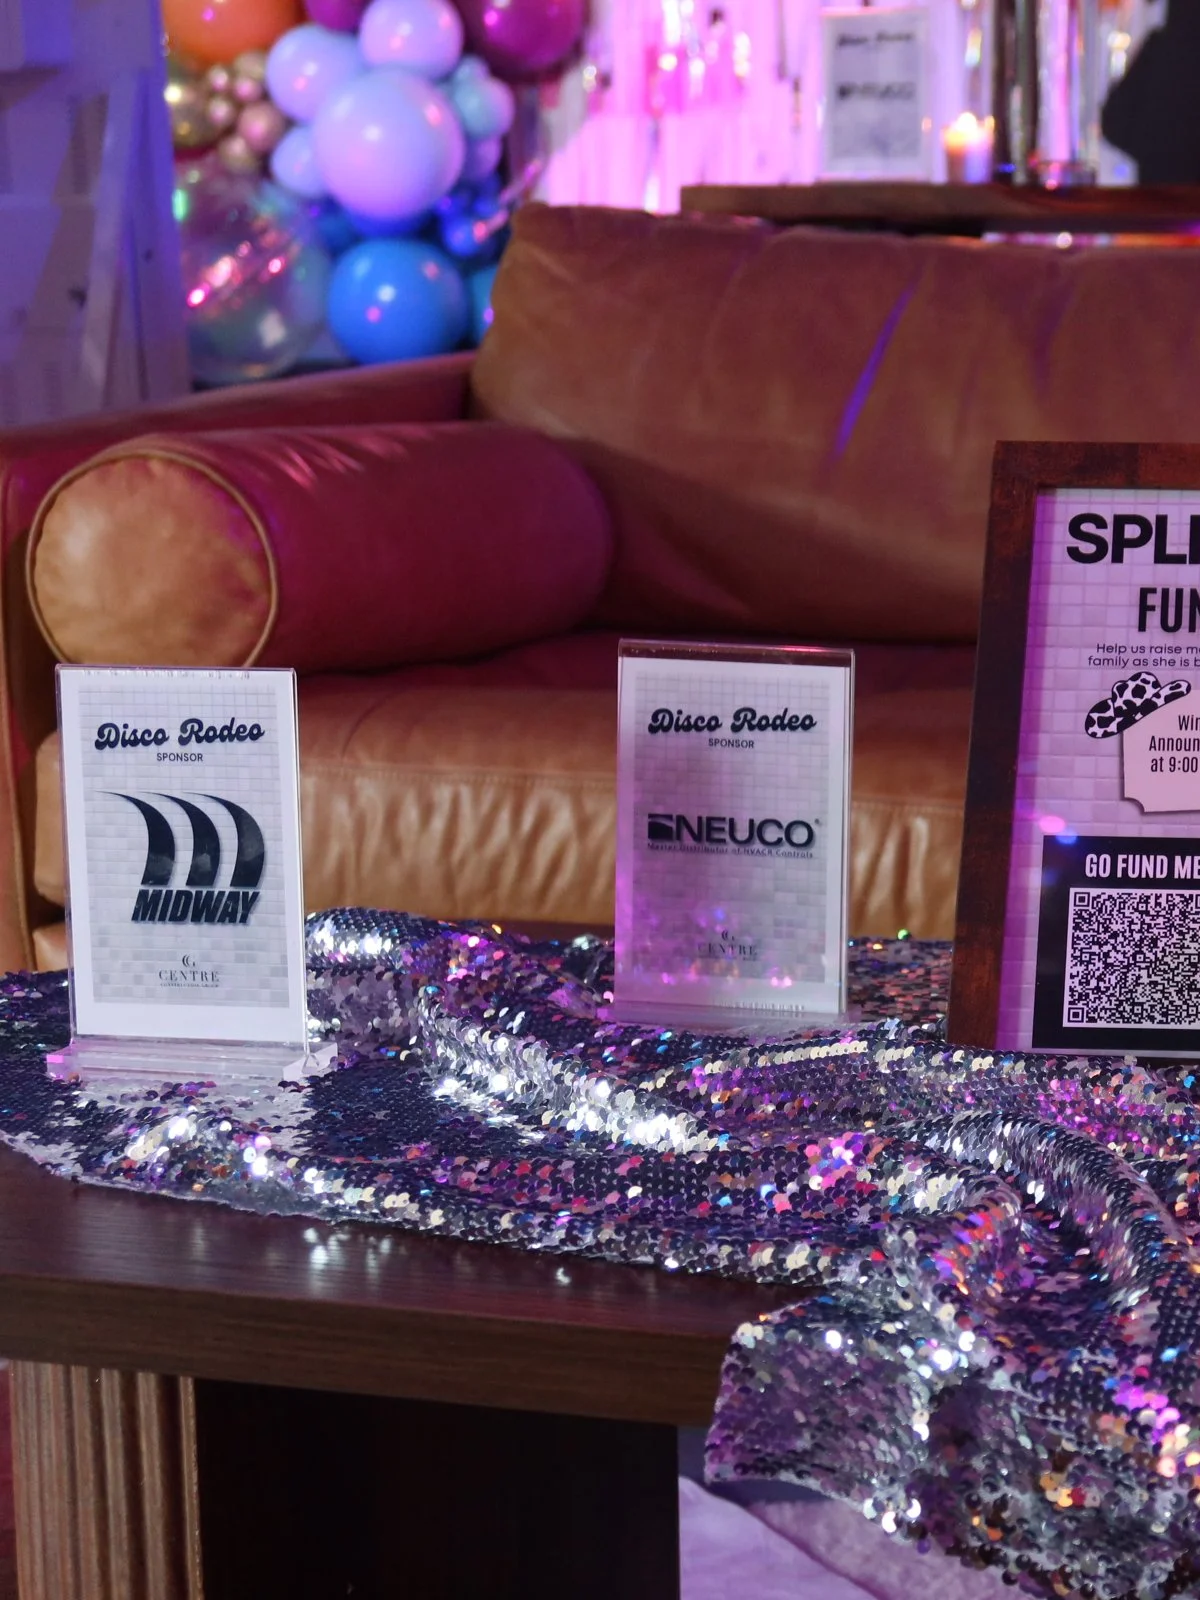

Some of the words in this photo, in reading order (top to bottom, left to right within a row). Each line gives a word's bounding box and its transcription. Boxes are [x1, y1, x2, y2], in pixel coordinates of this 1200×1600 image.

[1096, 643, 1127, 655] Help
[1130, 645, 1146, 654] us
[1149, 644, 1182, 654] raise
[1088, 655, 1130, 669] family
[1132, 658, 1149, 667] as
[1152, 656, 1176, 667] she
[1179, 657, 1190, 667] is
[647, 707, 723, 735] Disco
[730, 706, 818, 734] Rodeo
[94, 722, 170, 751] Disco
[178, 716, 266, 747] Rodeo
[708, 738, 755, 749] SPONSOR
[156, 752, 204, 762] SPONSOR
[1150, 756, 1164, 773] at
[1168, 756, 1199, 773] 9:00
[675, 814, 815, 849] NEUCO
[1084, 853, 1111, 878] GO
[1116, 854, 1169, 879] FUND
[131, 889, 261, 924] MIDWAY
